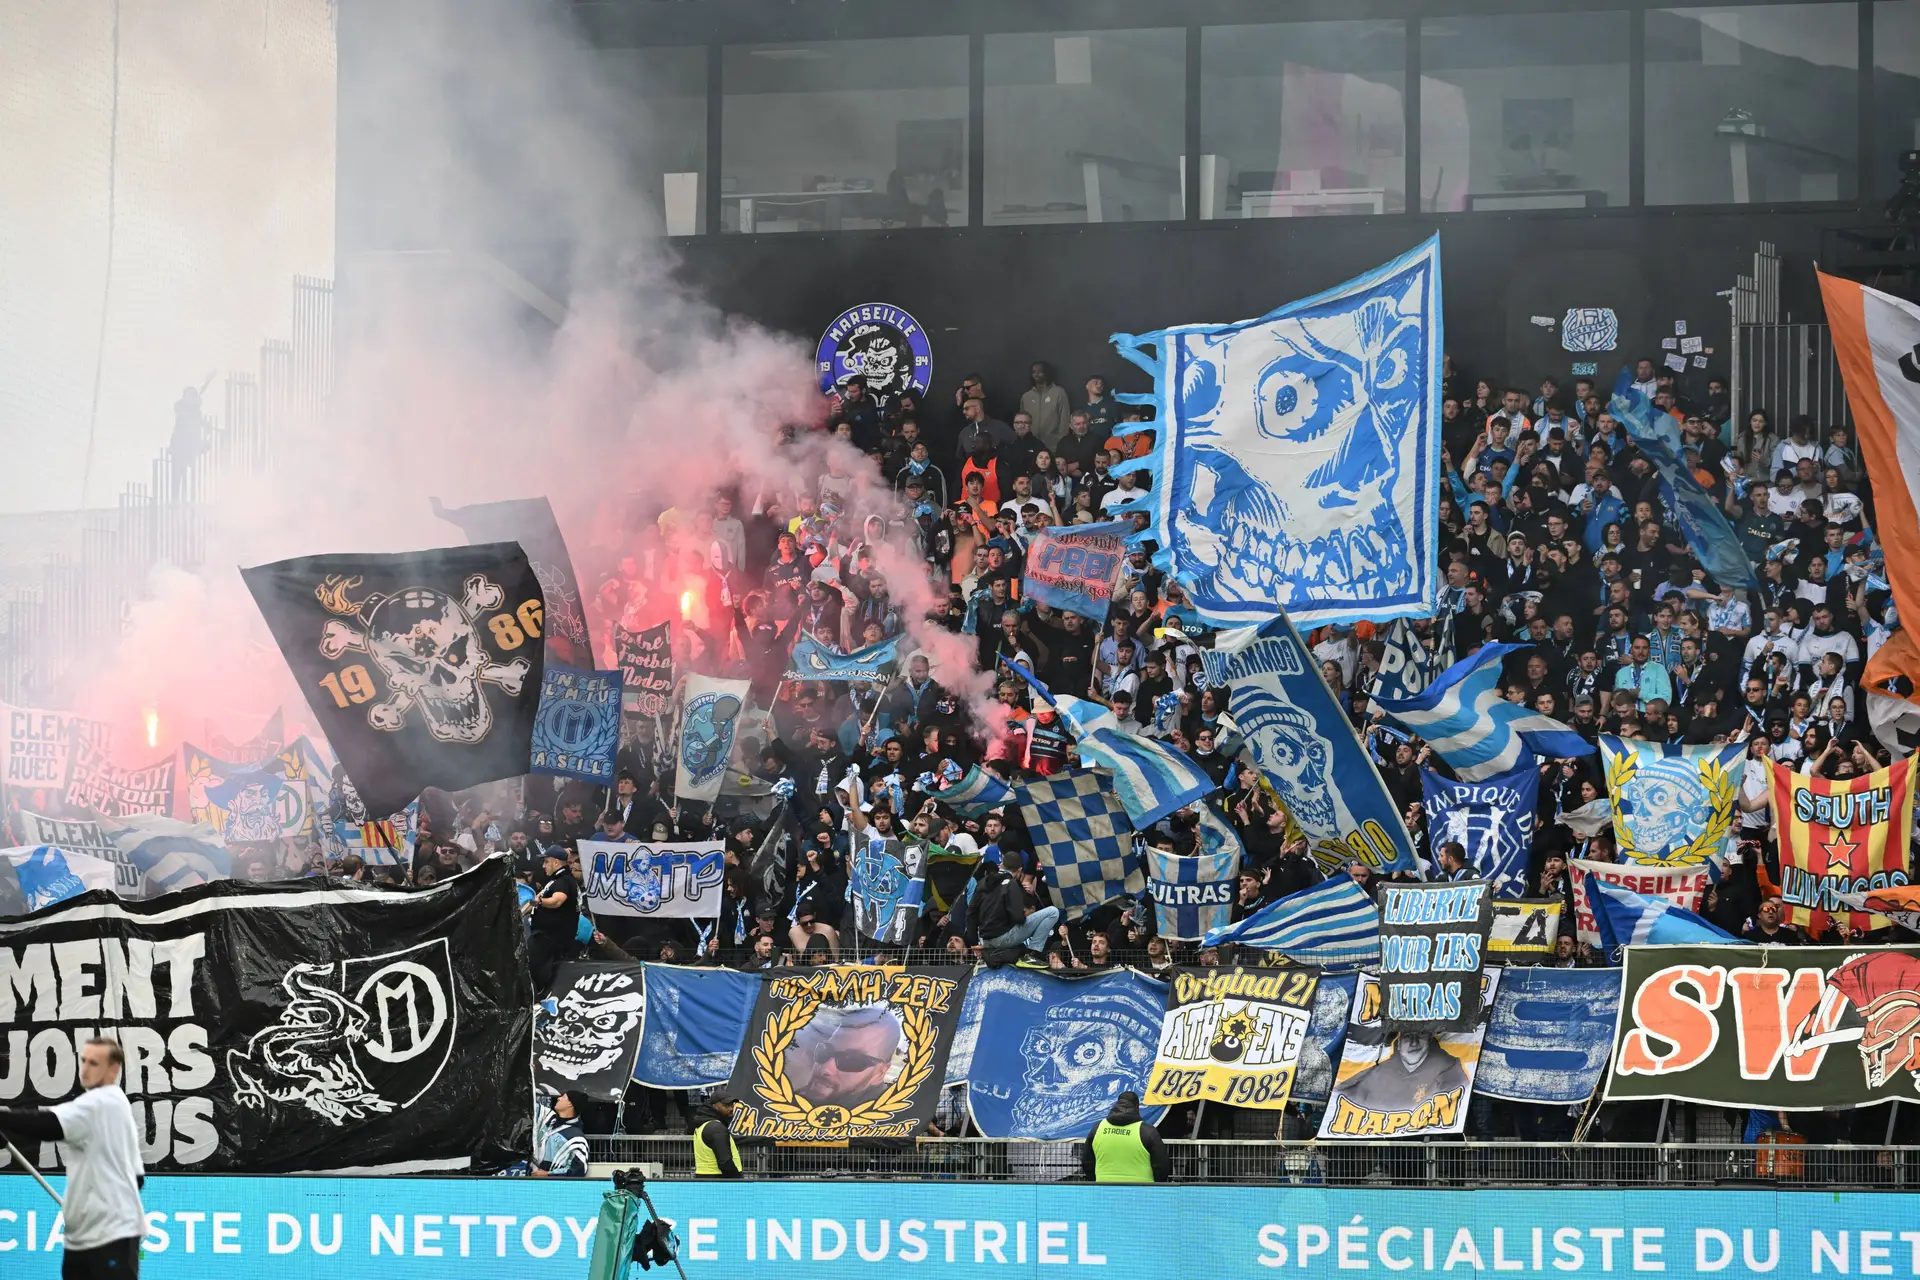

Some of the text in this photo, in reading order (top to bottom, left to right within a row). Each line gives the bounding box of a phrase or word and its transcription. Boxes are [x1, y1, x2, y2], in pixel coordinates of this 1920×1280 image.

[828, 306, 917, 343] MARSEILLE
[819, 355, 929, 373] 19 94
[318, 598, 545, 708] 19 86
[1152, 883, 1231, 905] ULTRAS
[1384, 883, 1487, 925] LIBERTE
[1431, 933, 1482, 972] LES
[574, 972, 634, 993] MTP
[1174, 966, 1289, 1004] Original
[1281, 973, 1319, 1007] 21
[1152, 1068, 1207, 1099] 1975
[1221, 1070, 1289, 1105] 1982
[1102, 1126, 1131, 1137] STADIER
[267, 1212, 343, 1256] DU
[370, 1213, 719, 1260] NETTOYE
[745, 1217, 1107, 1264] INDUSTRIEL
[1256, 1213, 1666, 1271] SPÉCIALISTE
[1695, 1227, 1780, 1273] DU
